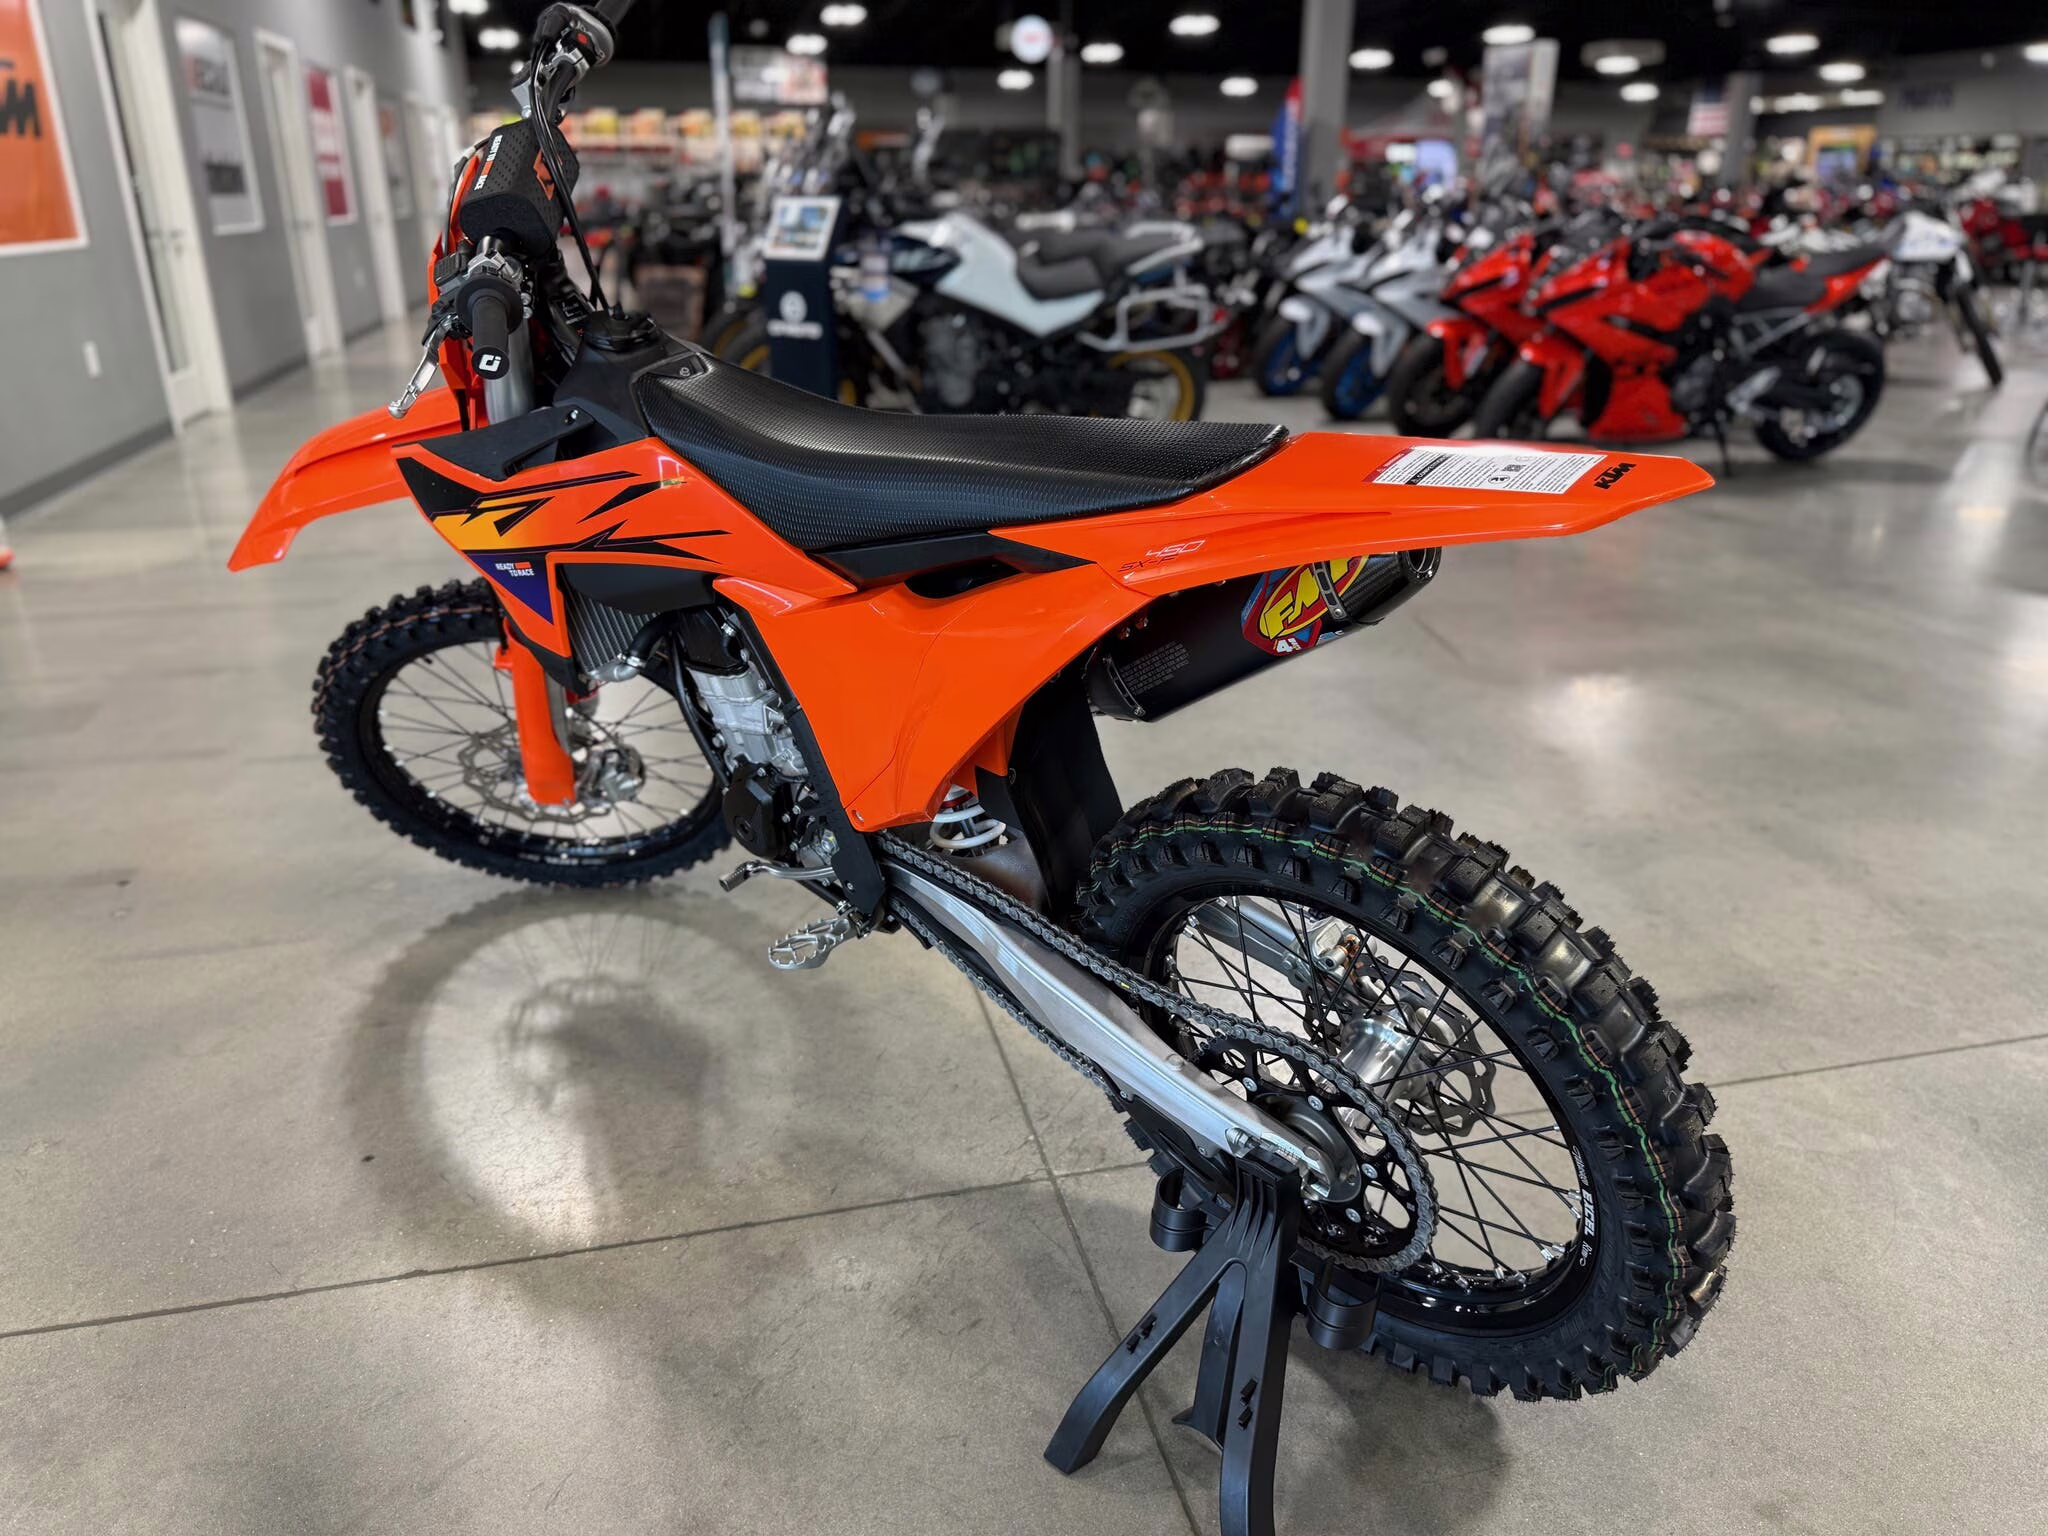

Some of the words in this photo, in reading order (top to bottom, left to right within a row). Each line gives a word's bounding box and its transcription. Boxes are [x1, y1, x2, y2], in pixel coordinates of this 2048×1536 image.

[1593, 462, 1637, 490] KTM
[495, 562, 515, 571] READY
[1581, 1188, 1595, 1237] EXCEL
